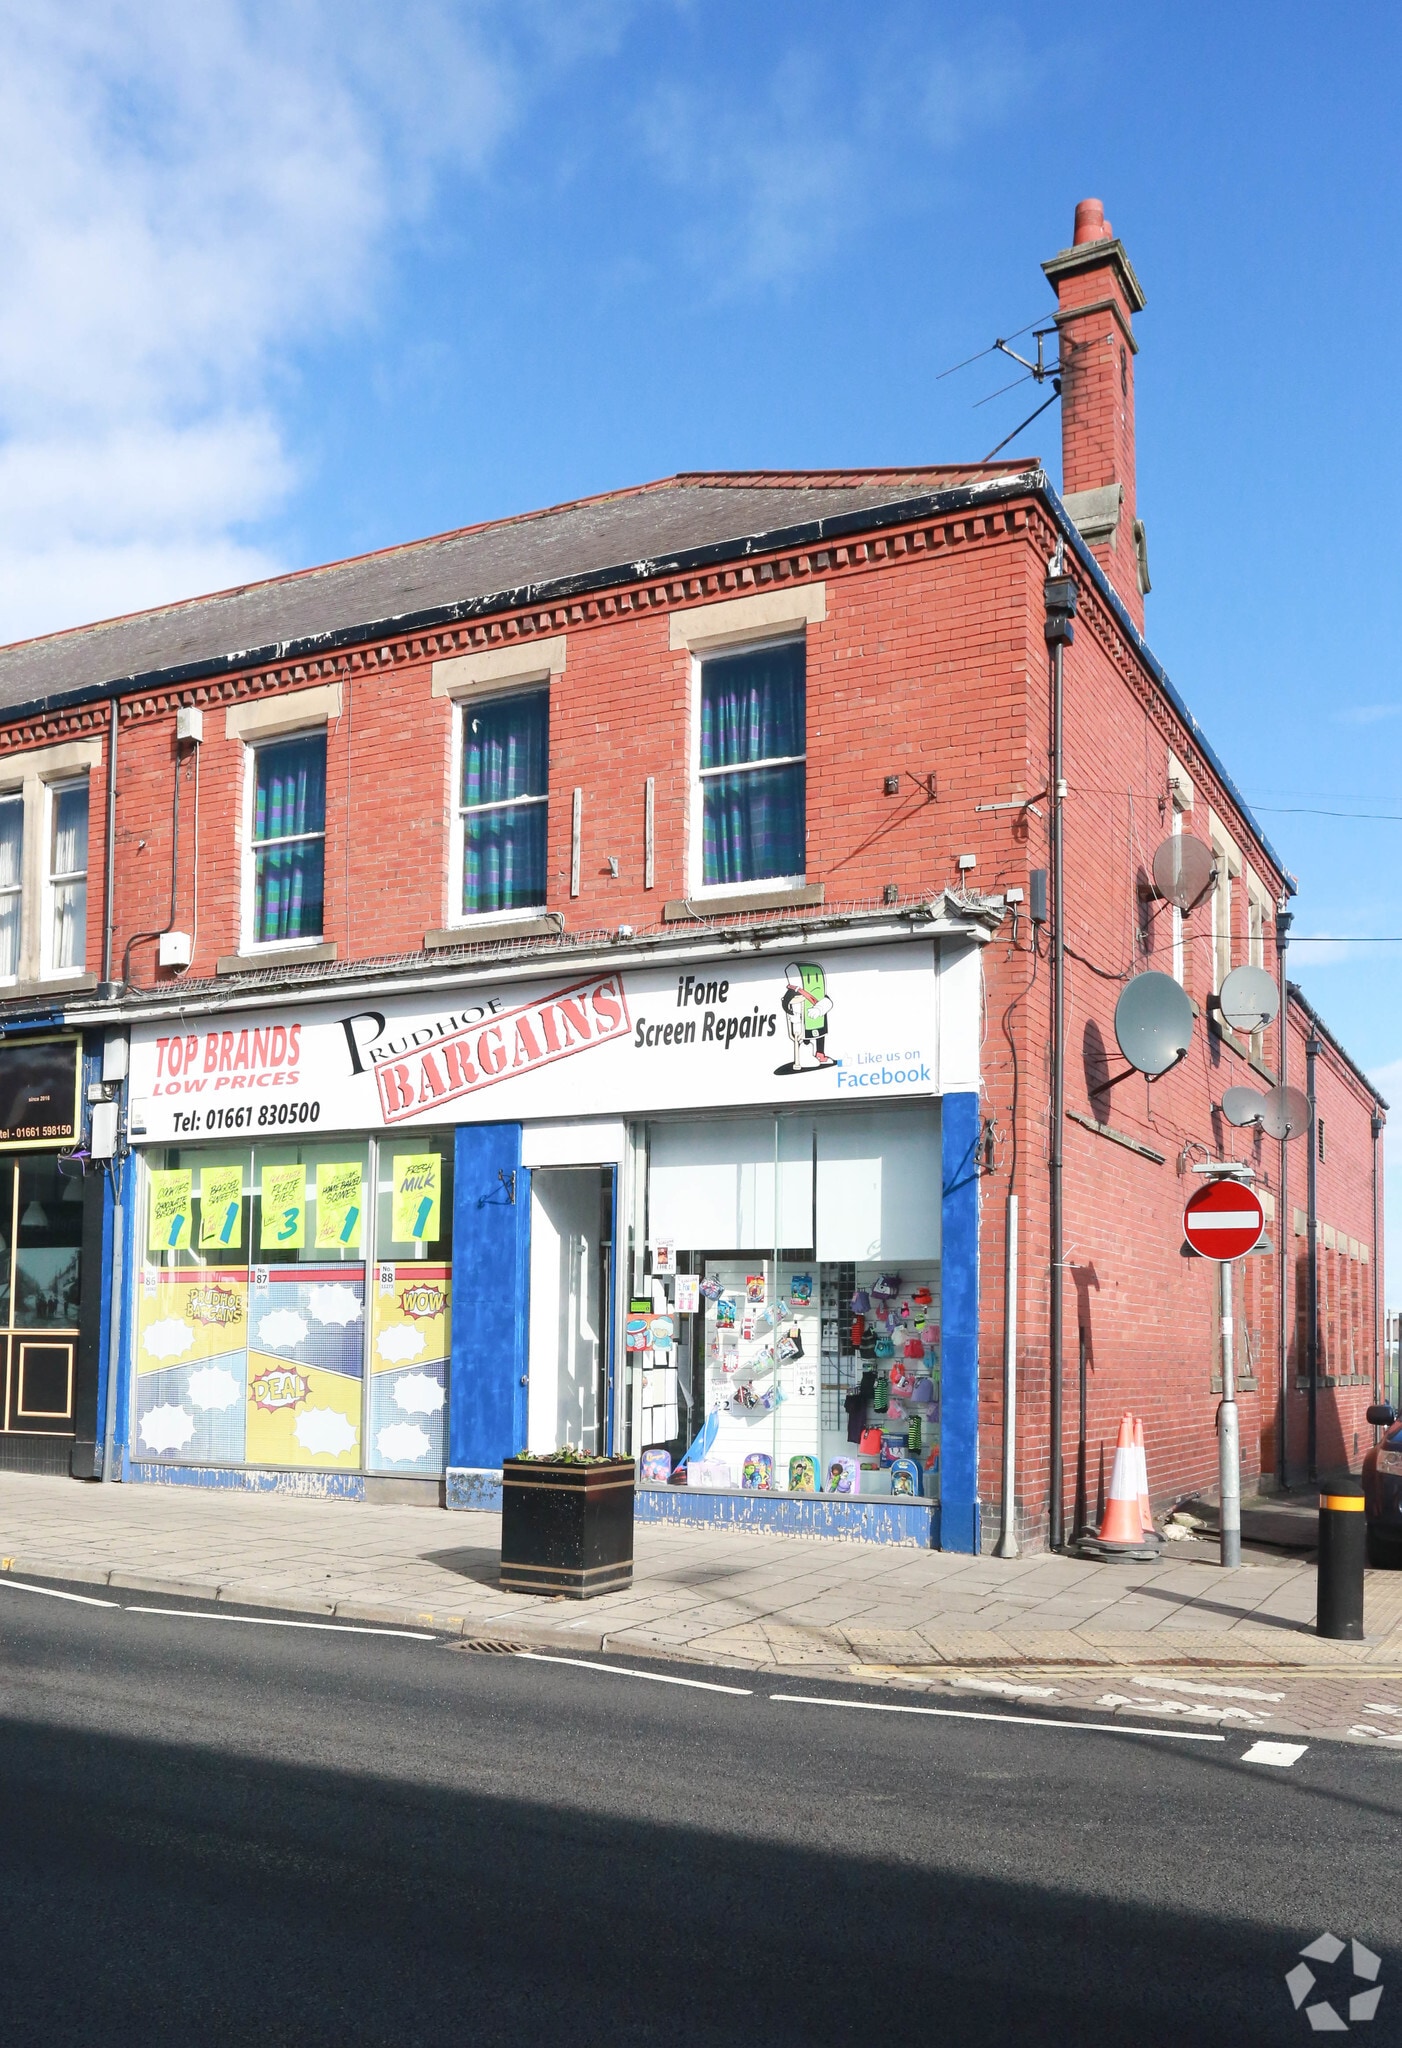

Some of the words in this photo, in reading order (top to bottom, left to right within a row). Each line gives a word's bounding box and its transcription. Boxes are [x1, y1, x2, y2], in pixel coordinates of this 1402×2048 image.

[677, 976, 730, 1007] iFone
[334, 997, 505, 1076] PRUDHOE
[634, 1018, 696, 1048] Screen
[702, 1006, 777, 1049] Repairs
[156, 1034, 199, 1078] TOP
[203, 1023, 302, 1073] BRANDS
[381, 980, 623, 1115] BARGAINS
[857, 1052, 882, 1065] Like
[887, 1053, 901, 1061] us
[904, 1050, 920, 1060] on
[152, 1079, 208, 1096] LOW
[214, 1071, 300, 1090] PRICES
[837, 1064, 931, 1088] Facebook
[173, 1110, 201, 1132] Tel:
[206, 1106, 253, 1130] 01661
[257, 1101, 320, 1126] 830500
[0, 1129, 10, 1139] tel
[16, 1127, 40, 1138] 01661
[42, 1124, 72, 1136] 598150
[271, 1177, 301, 1194] PLATE
[400, 1172, 435, 1193] MILK
[272, 1188, 295, 1204] PIES
[325, 1187, 357, 1204] SCONES
[256, 1274, 268, 1284] 87
[382, 1273, 394, 1283] 88
[189, 1289, 242, 1309] PRUDHOE
[402, 1291, 444, 1312] WOW
[186, 1303, 243, 1323] BARGAINS
[251, 1375, 306, 1402] DEAL
[798, 1385, 816, 1396] £2
